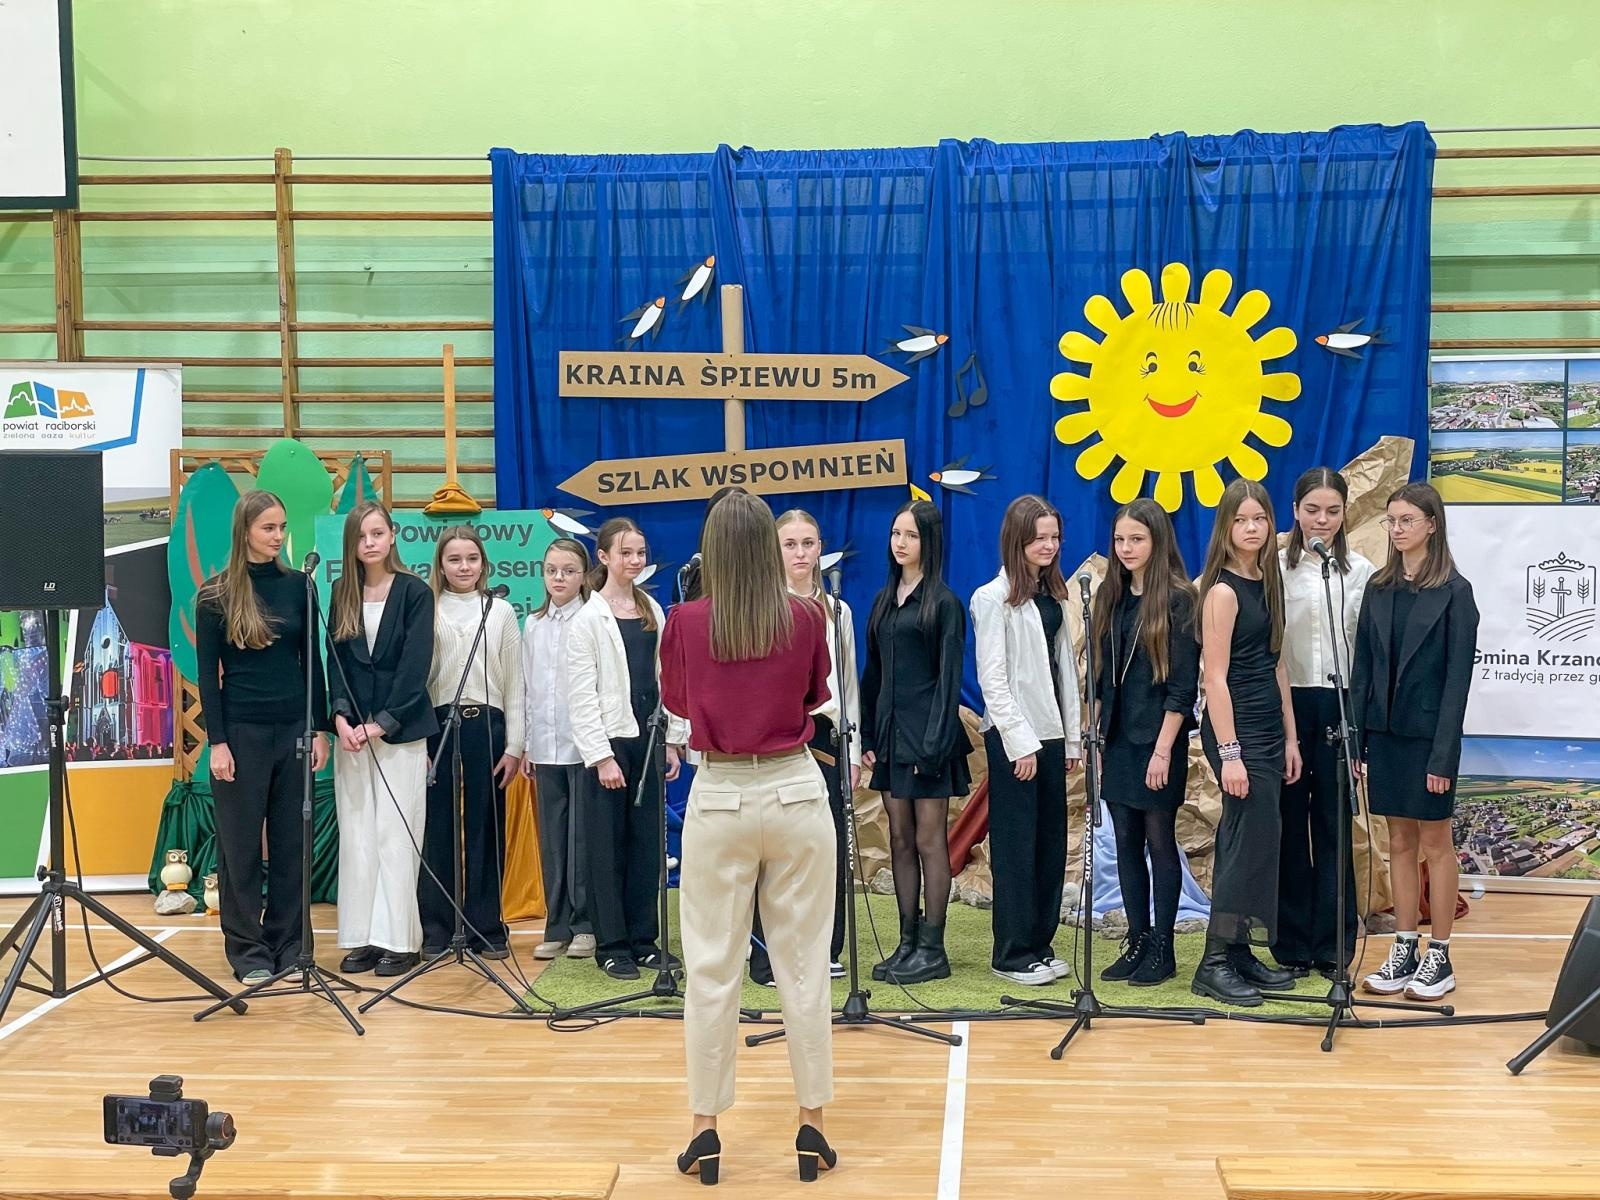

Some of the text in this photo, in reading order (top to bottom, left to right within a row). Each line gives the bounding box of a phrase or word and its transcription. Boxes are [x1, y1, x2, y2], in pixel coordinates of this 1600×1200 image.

[566, 364, 685, 387] KRAINA
[832, 368, 877, 389] 5m
[3, 421, 96, 432] powiat raciborski
[598, 467, 691, 493] SZLAK
[1482, 668, 1490, 680] Z
[1495, 668, 1544, 684] tradycją
[1549, 673, 1584, 684] przez
